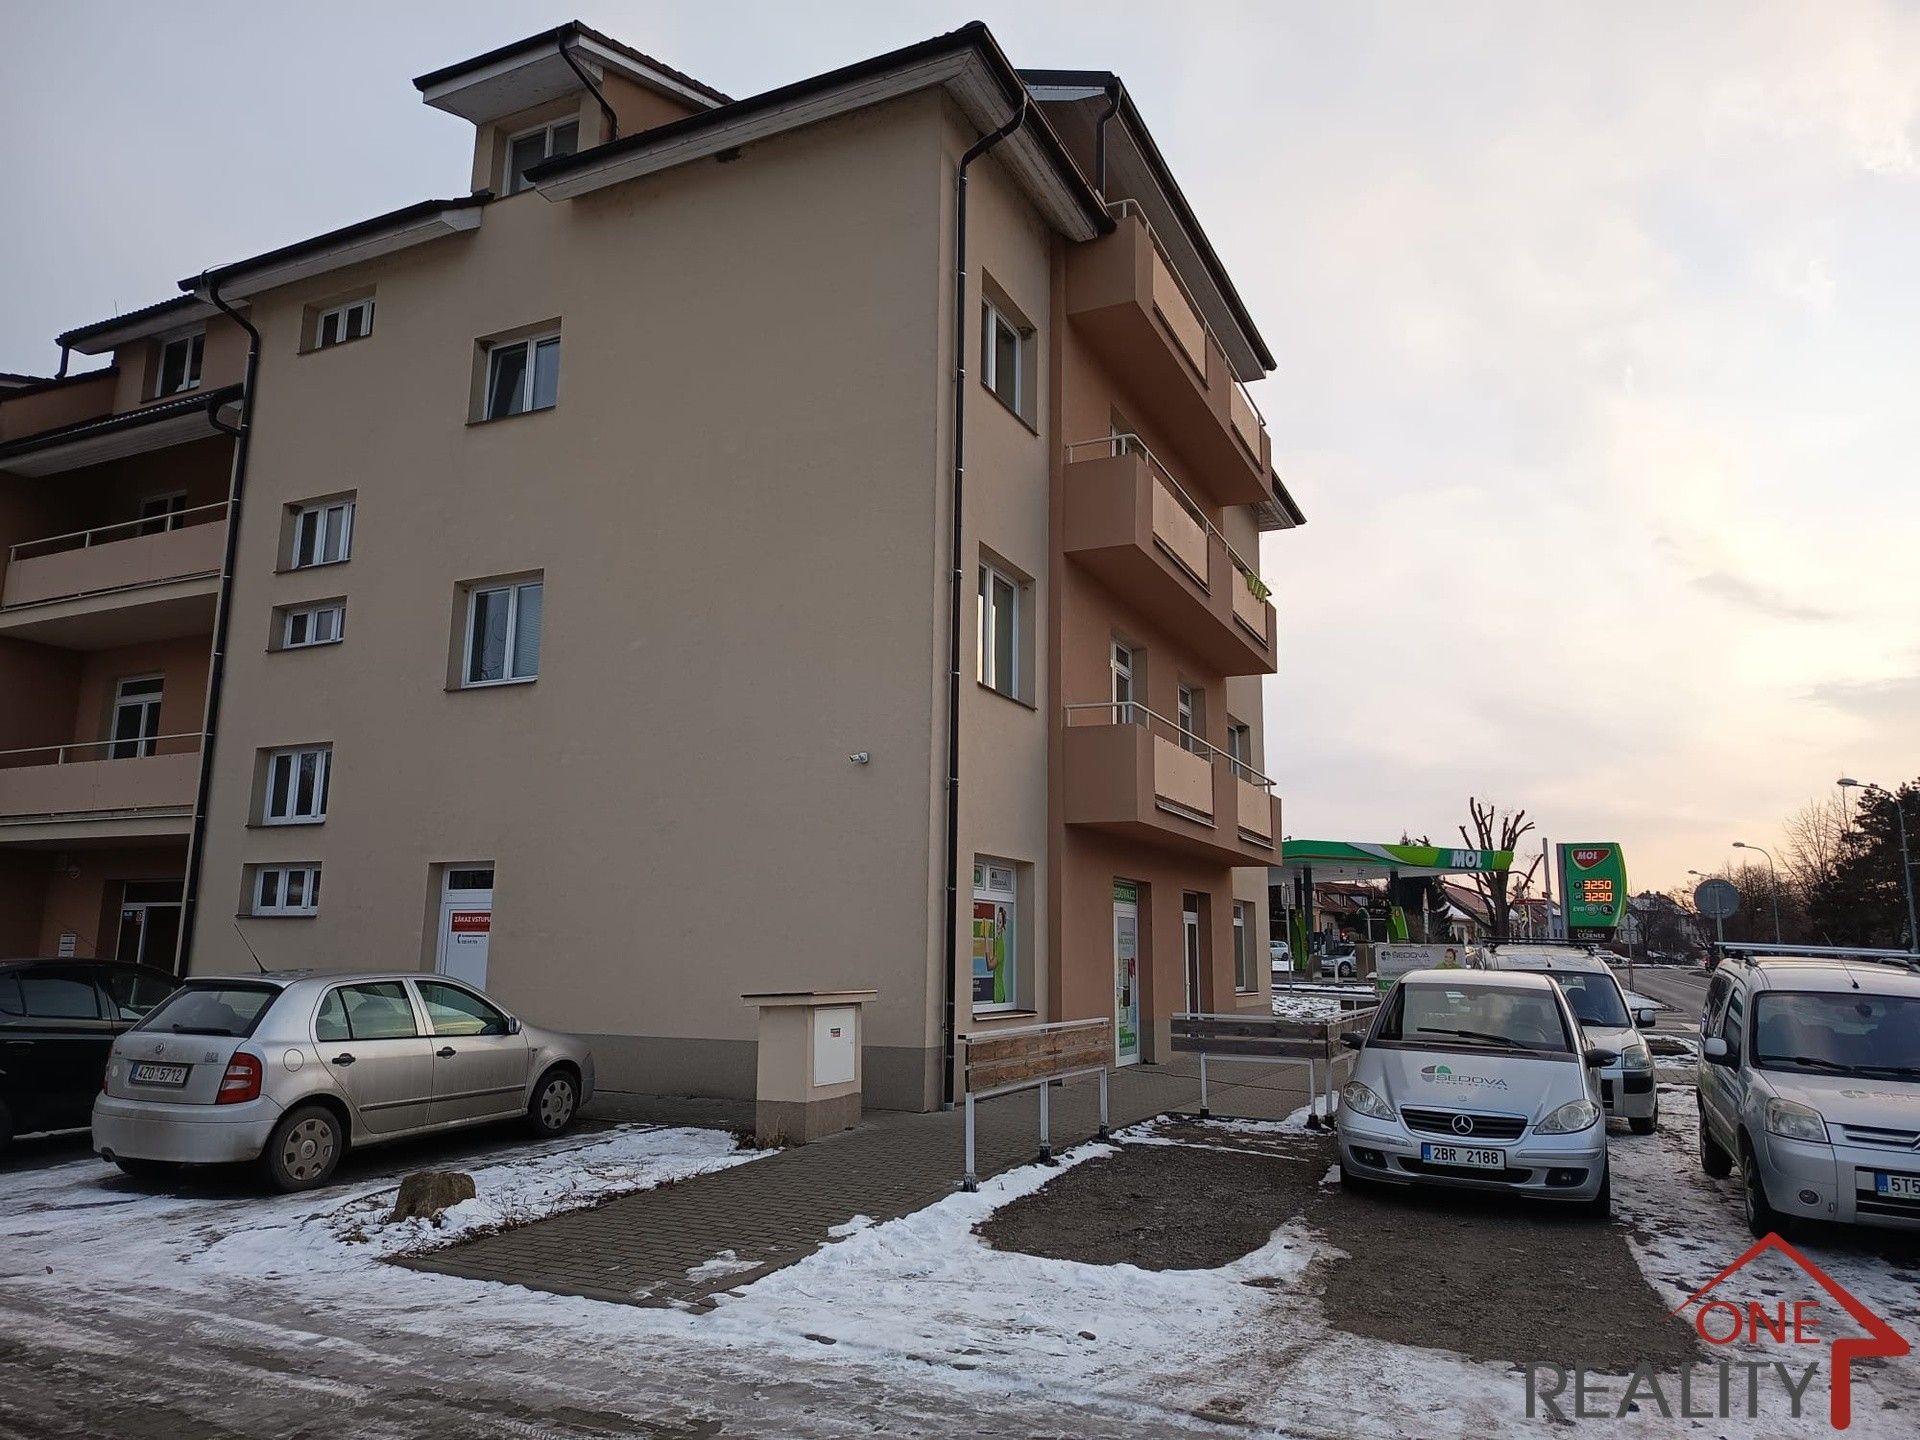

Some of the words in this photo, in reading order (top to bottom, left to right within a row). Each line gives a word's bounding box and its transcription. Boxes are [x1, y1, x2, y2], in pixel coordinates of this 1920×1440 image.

[1451, 850, 1483, 868] MOL
[1577, 851, 1598, 860] MOL
[160, 1068, 182, 1082] 5712
[1433, 1147, 1457, 1162] 2BR
[1466, 1150, 1499, 1165] 2188
[1891, 1177, 1920, 1194] 5T5
